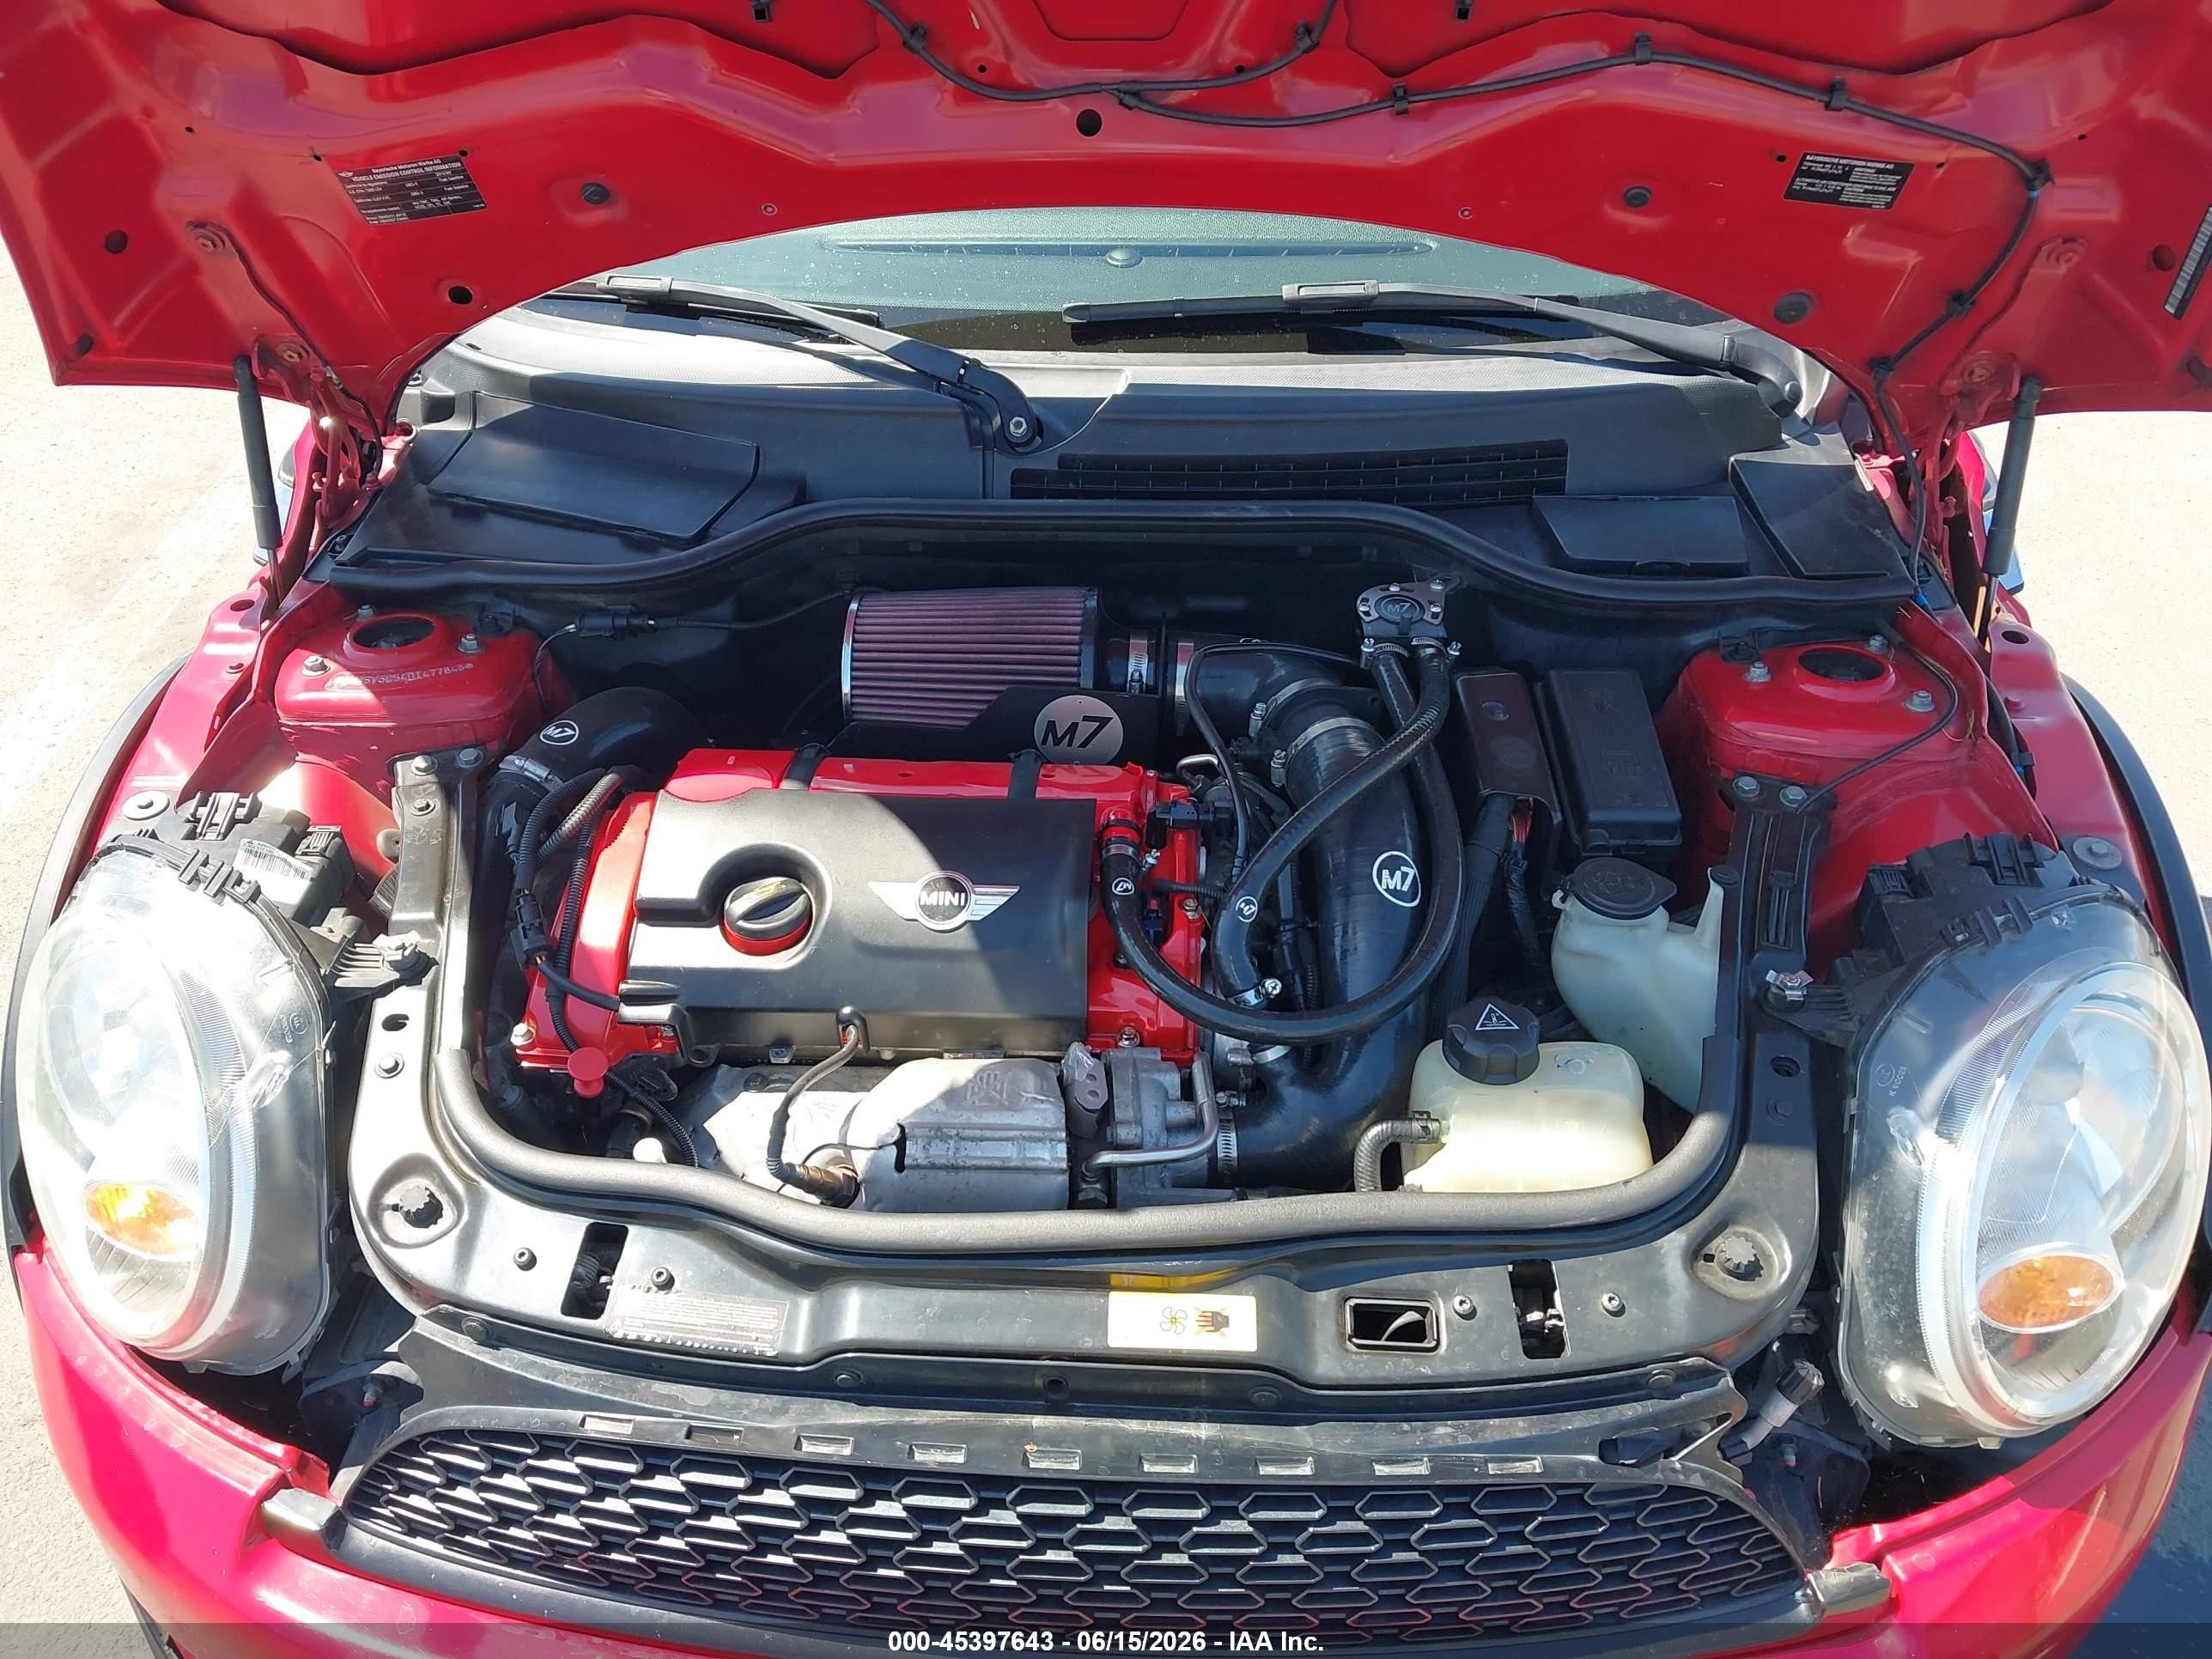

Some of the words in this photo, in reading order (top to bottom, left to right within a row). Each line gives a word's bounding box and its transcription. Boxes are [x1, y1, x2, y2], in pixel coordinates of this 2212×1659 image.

[374, 171, 400, 179] EMISSION
[399, 167, 425, 176] CONTROL
[424, 161, 462, 172] INFORMATION
[1388, 602, 1412, 612] M7
[543, 726, 576, 738] M7
[1041, 715, 1114, 749] M7
[1381, 866, 1415, 892] M7
[920, 890, 966, 907] MINI
